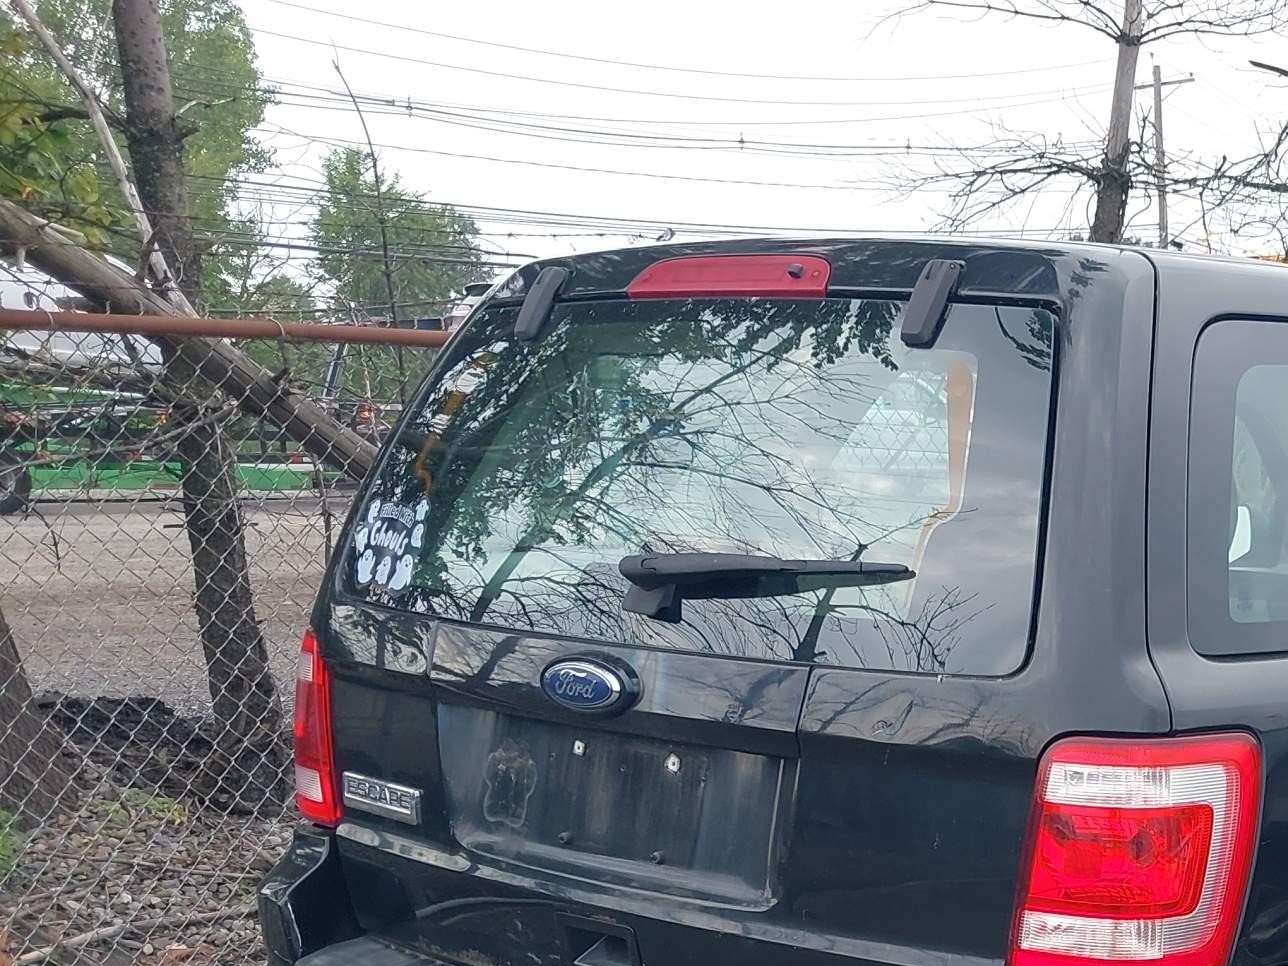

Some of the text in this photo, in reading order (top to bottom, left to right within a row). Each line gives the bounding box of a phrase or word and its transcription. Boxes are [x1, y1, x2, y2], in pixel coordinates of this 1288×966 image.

[370, 520, 409, 556] Ghouls
[555, 668, 598, 699] Ford
[347, 777, 412, 811] ESCAPE
